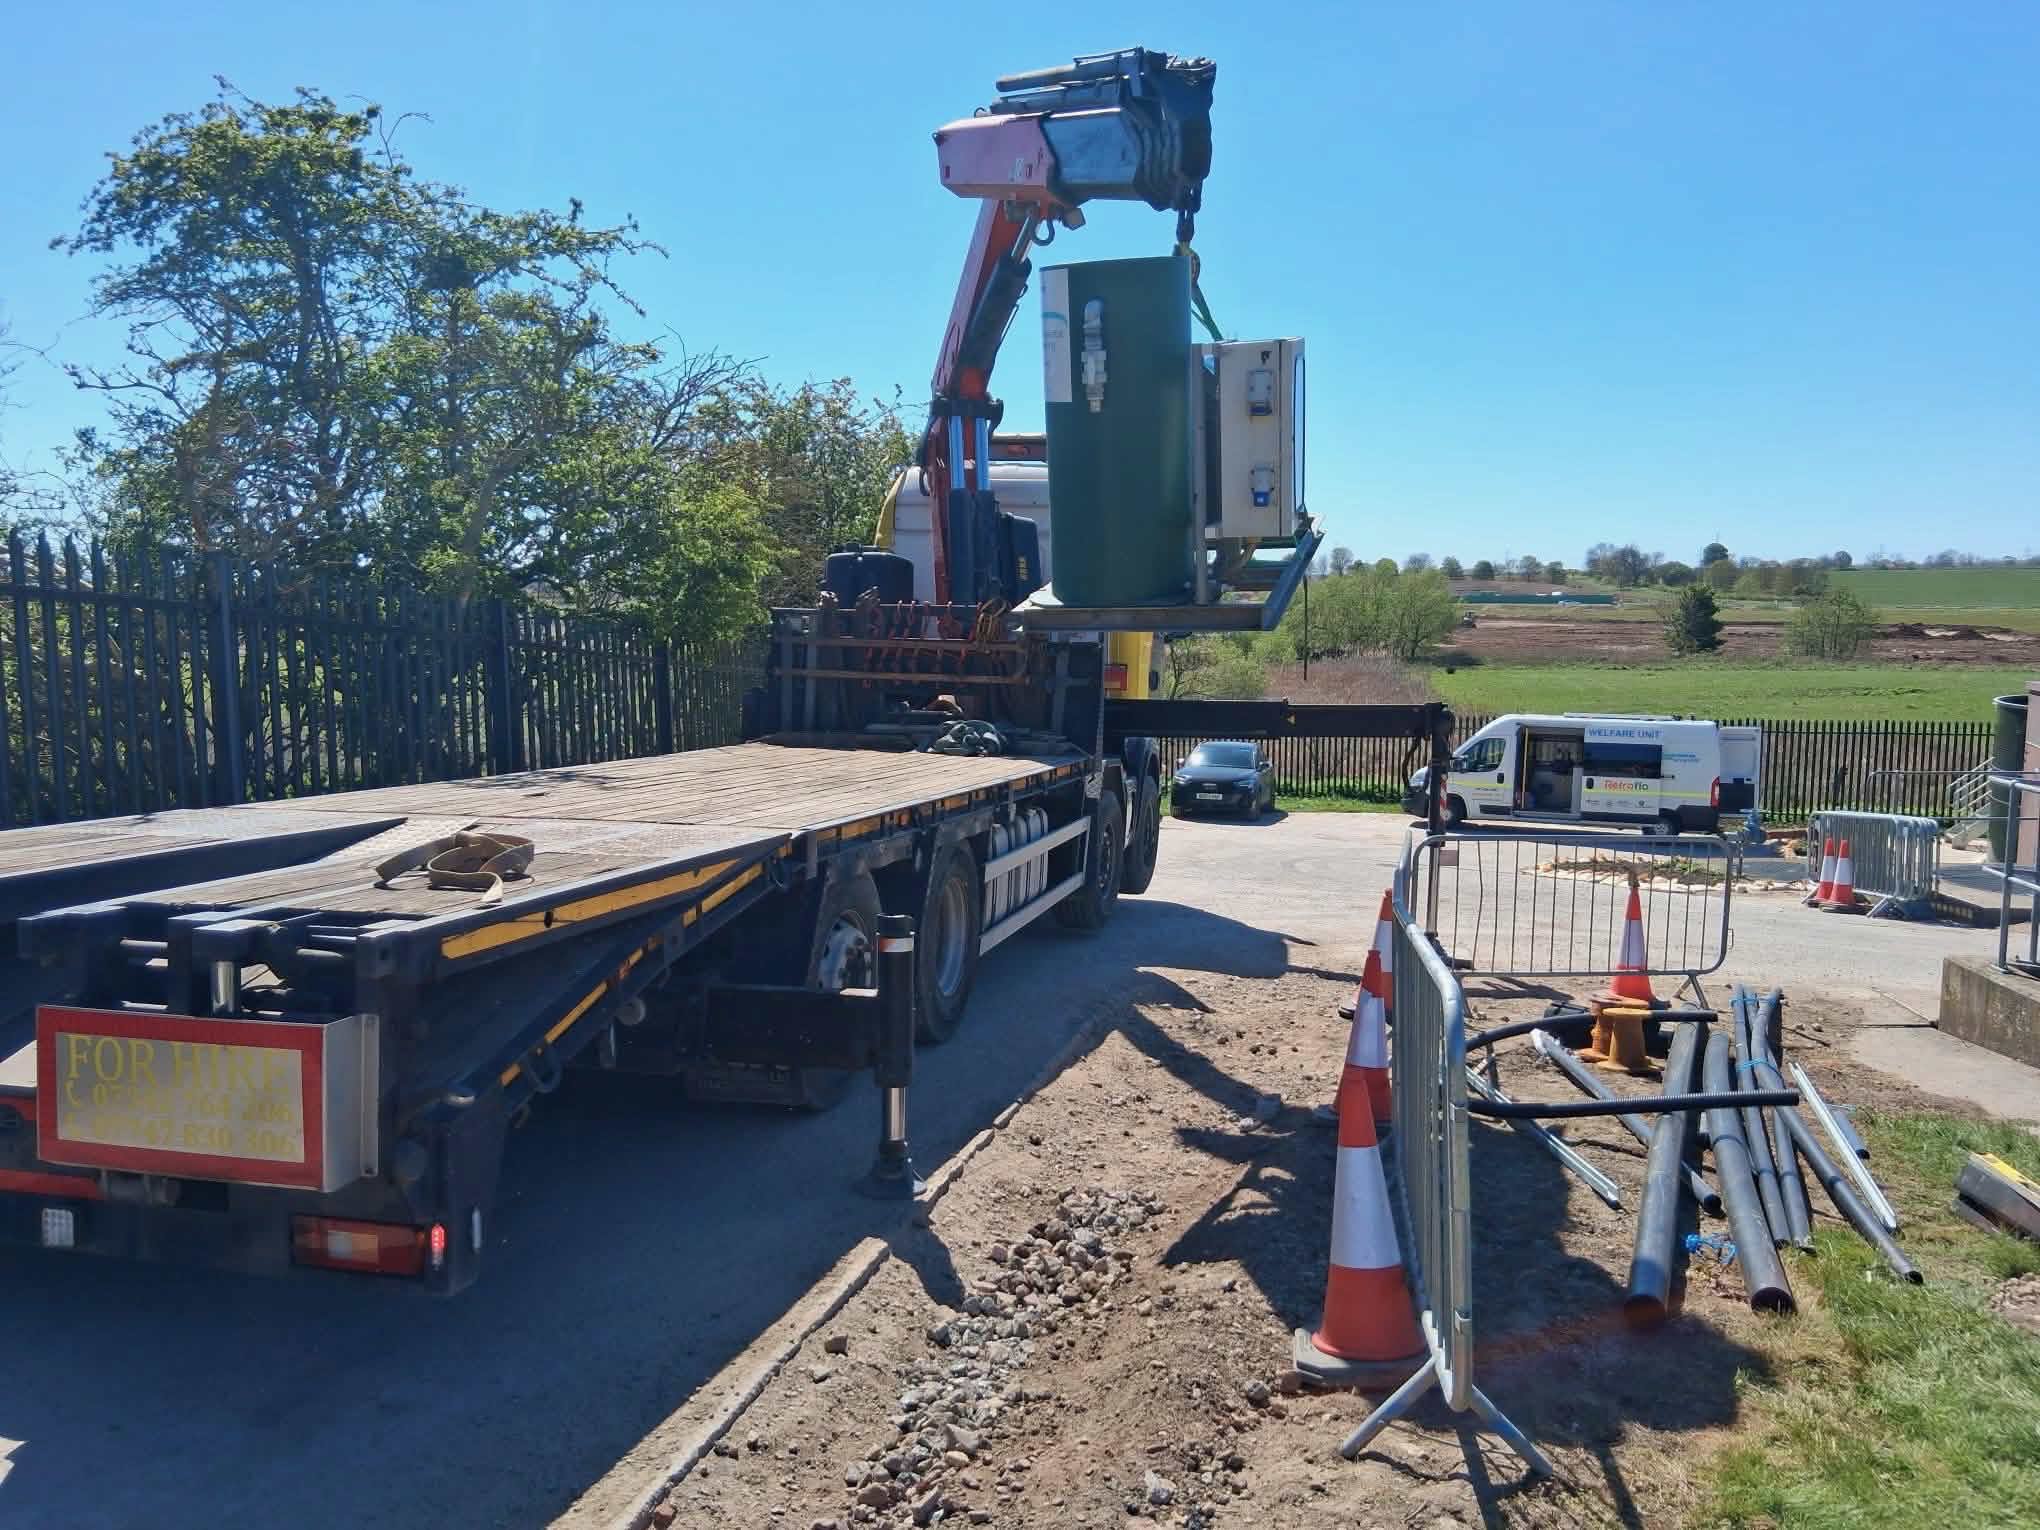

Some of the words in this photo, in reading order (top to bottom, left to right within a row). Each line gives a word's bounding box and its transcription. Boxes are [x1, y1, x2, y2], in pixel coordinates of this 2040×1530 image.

[1588, 727, 1634, 738] WELFARE
[1637, 728, 1660, 739] UNIT
[66, 1034, 156, 1088] FOR
[171, 1042, 290, 1094] HIRE
